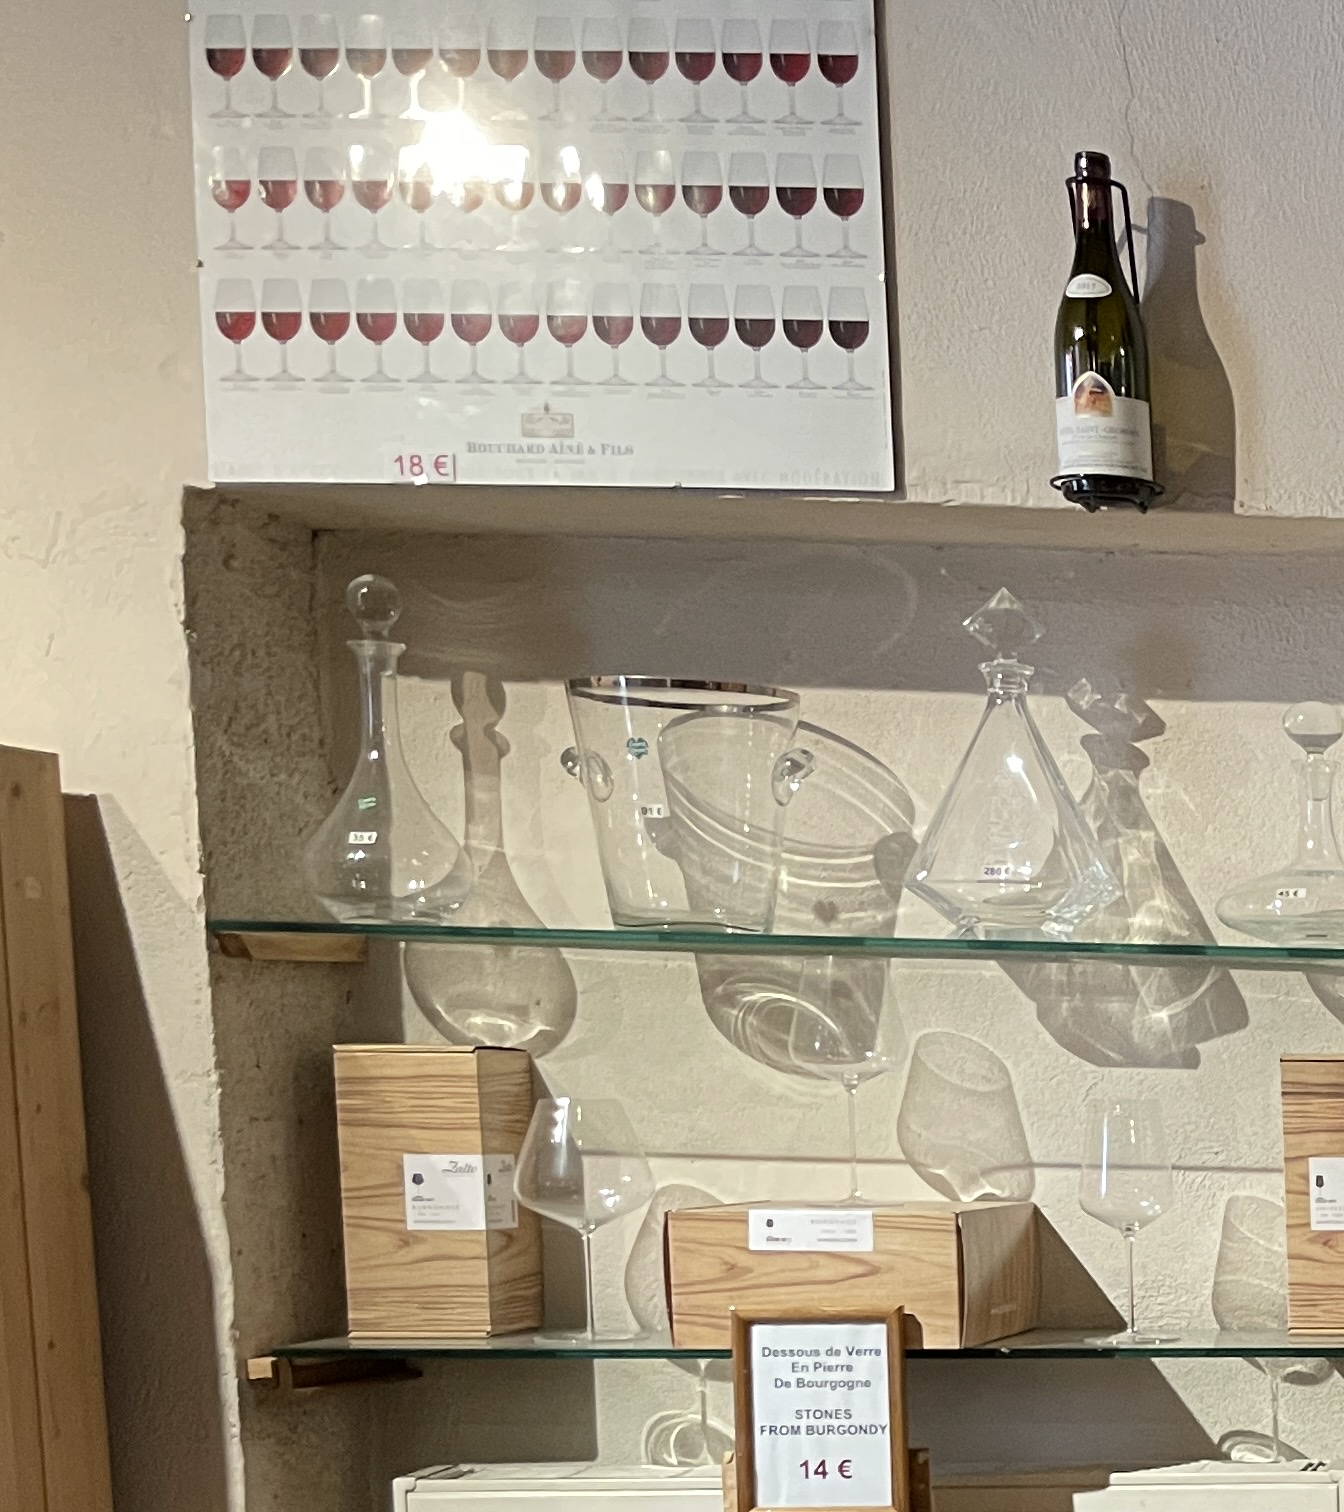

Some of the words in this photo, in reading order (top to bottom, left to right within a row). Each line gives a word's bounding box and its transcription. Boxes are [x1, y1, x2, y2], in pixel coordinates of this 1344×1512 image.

[394, 454, 424, 477] 18
[434, 454, 449, 477] €
[761, 1346, 821, 1358] Dessous
[825, 1346, 841, 1357] de
[845, 1346, 881, 1357] Verre
[791, 1362, 809, 1373] En
[813, 1362, 853, 1373] Pierre
[774, 1378, 791, 1389] De
[796, 1378, 872, 1391] Bourgogne
[795, 1408, 853, 1420] STONES
[760, 1425, 801, 1436] FROM
[805, 1424, 888, 1436] BURGONDY
[799, 1459, 829, 1480] 14
[837, 1459, 853, 1479] €
